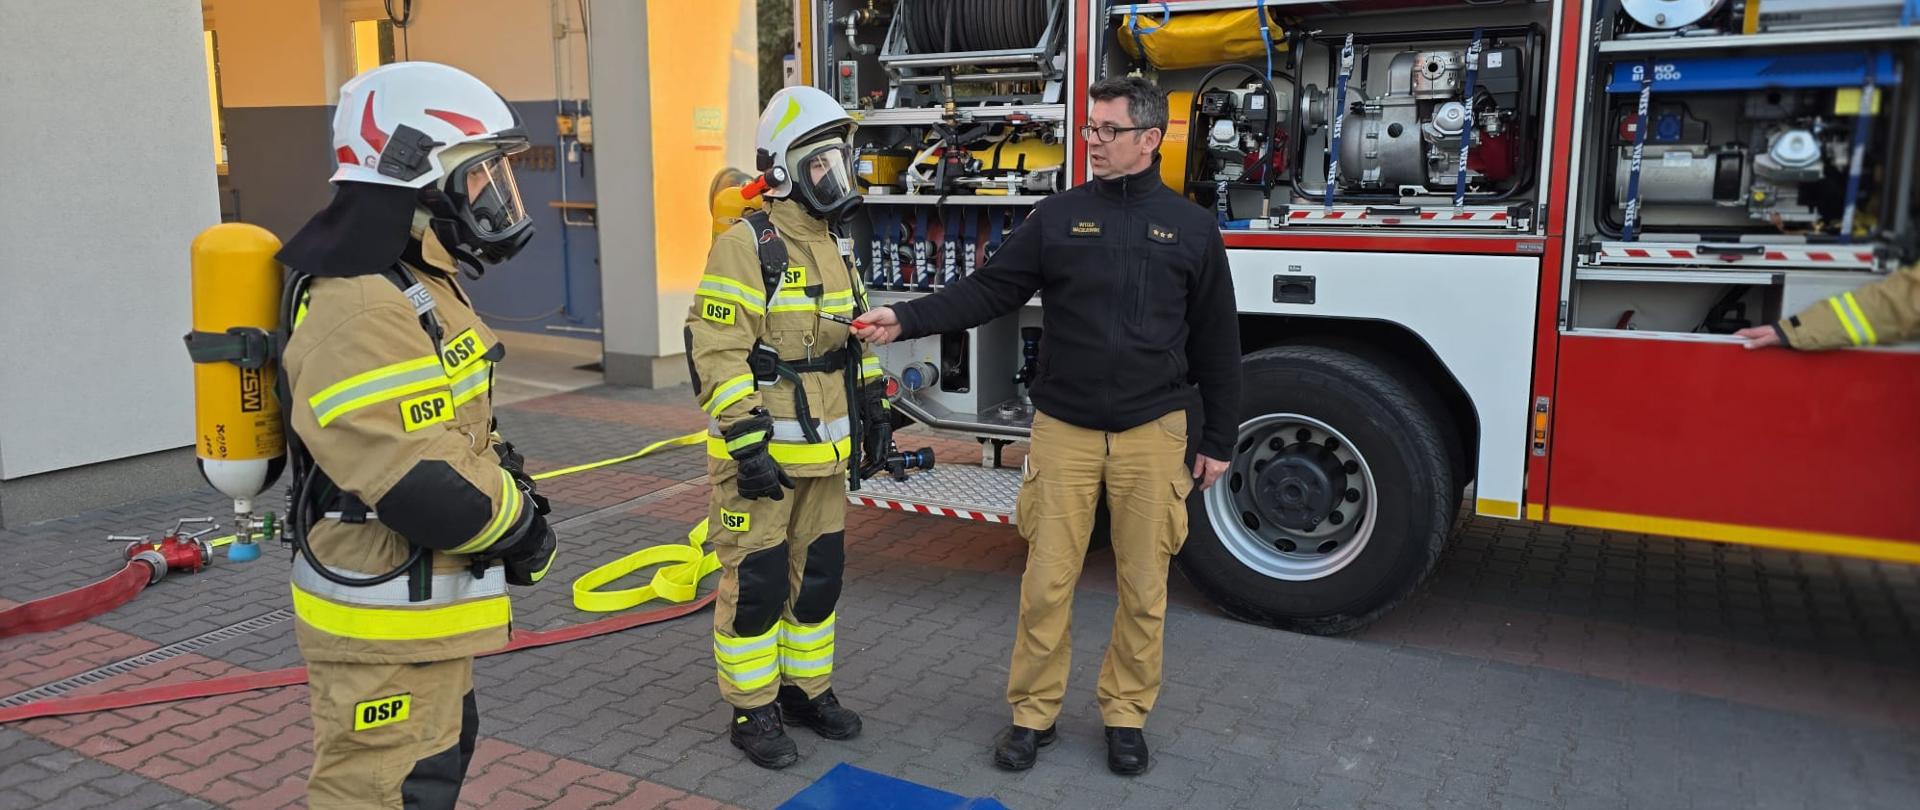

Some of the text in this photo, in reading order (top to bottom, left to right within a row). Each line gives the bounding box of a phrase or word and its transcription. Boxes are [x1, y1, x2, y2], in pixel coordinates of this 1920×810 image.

[1633, 64, 1675, 74] GKO
[1465, 96, 1474, 121] WISS
[1639, 86, 1650, 115] WISS
[1334, 114, 1343, 139] WISS
[1459, 145, 1469, 172] WISS
[1632, 143, 1643, 171] WISS
[1327, 160, 1337, 185] WISS
[1625, 198, 1636, 226] WISS
[872, 241, 882, 280] WISS
[890, 243, 901, 282] WISS
[915, 242, 927, 282] WISS
[945, 241, 956, 282] WISS
[784, 271, 801, 283] SP
[706, 303, 731, 320] OSP
[445, 336, 476, 368] OSP
[410, 397, 445, 424] OSP
[723, 513, 745, 528] OSP
[363, 700, 403, 724] OSP
